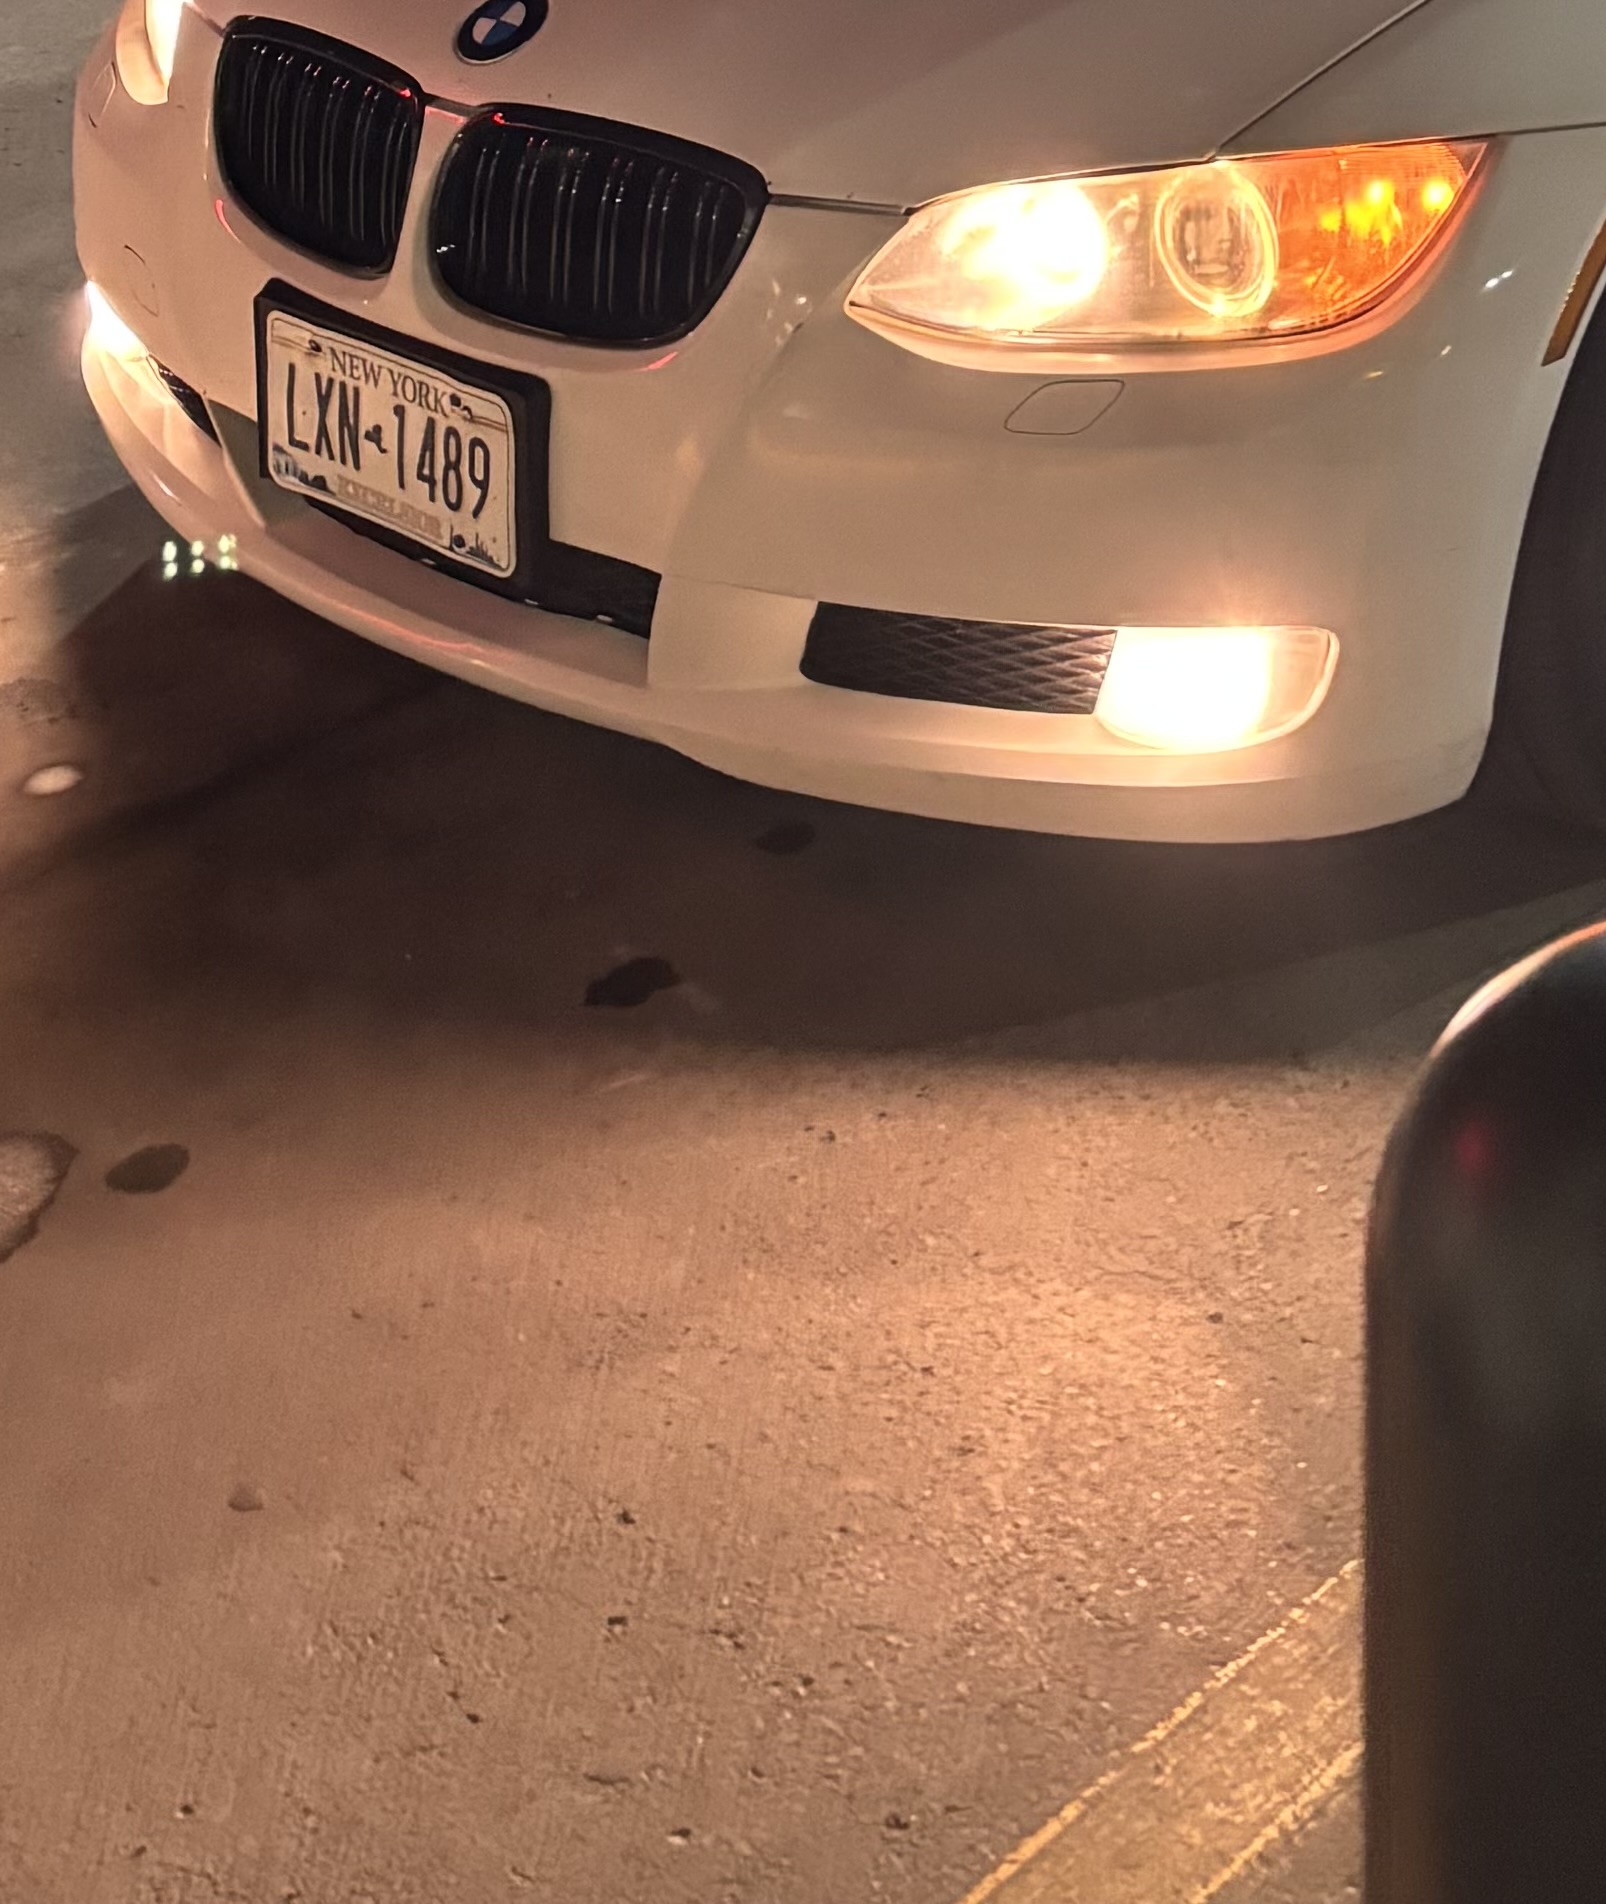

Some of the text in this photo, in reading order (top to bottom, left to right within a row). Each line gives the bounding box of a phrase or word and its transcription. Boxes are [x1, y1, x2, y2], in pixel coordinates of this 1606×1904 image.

[330, 347, 449, 417] NEW YORK
[286, 362, 361, 472] LXN
[393, 403, 491, 520] 1489
